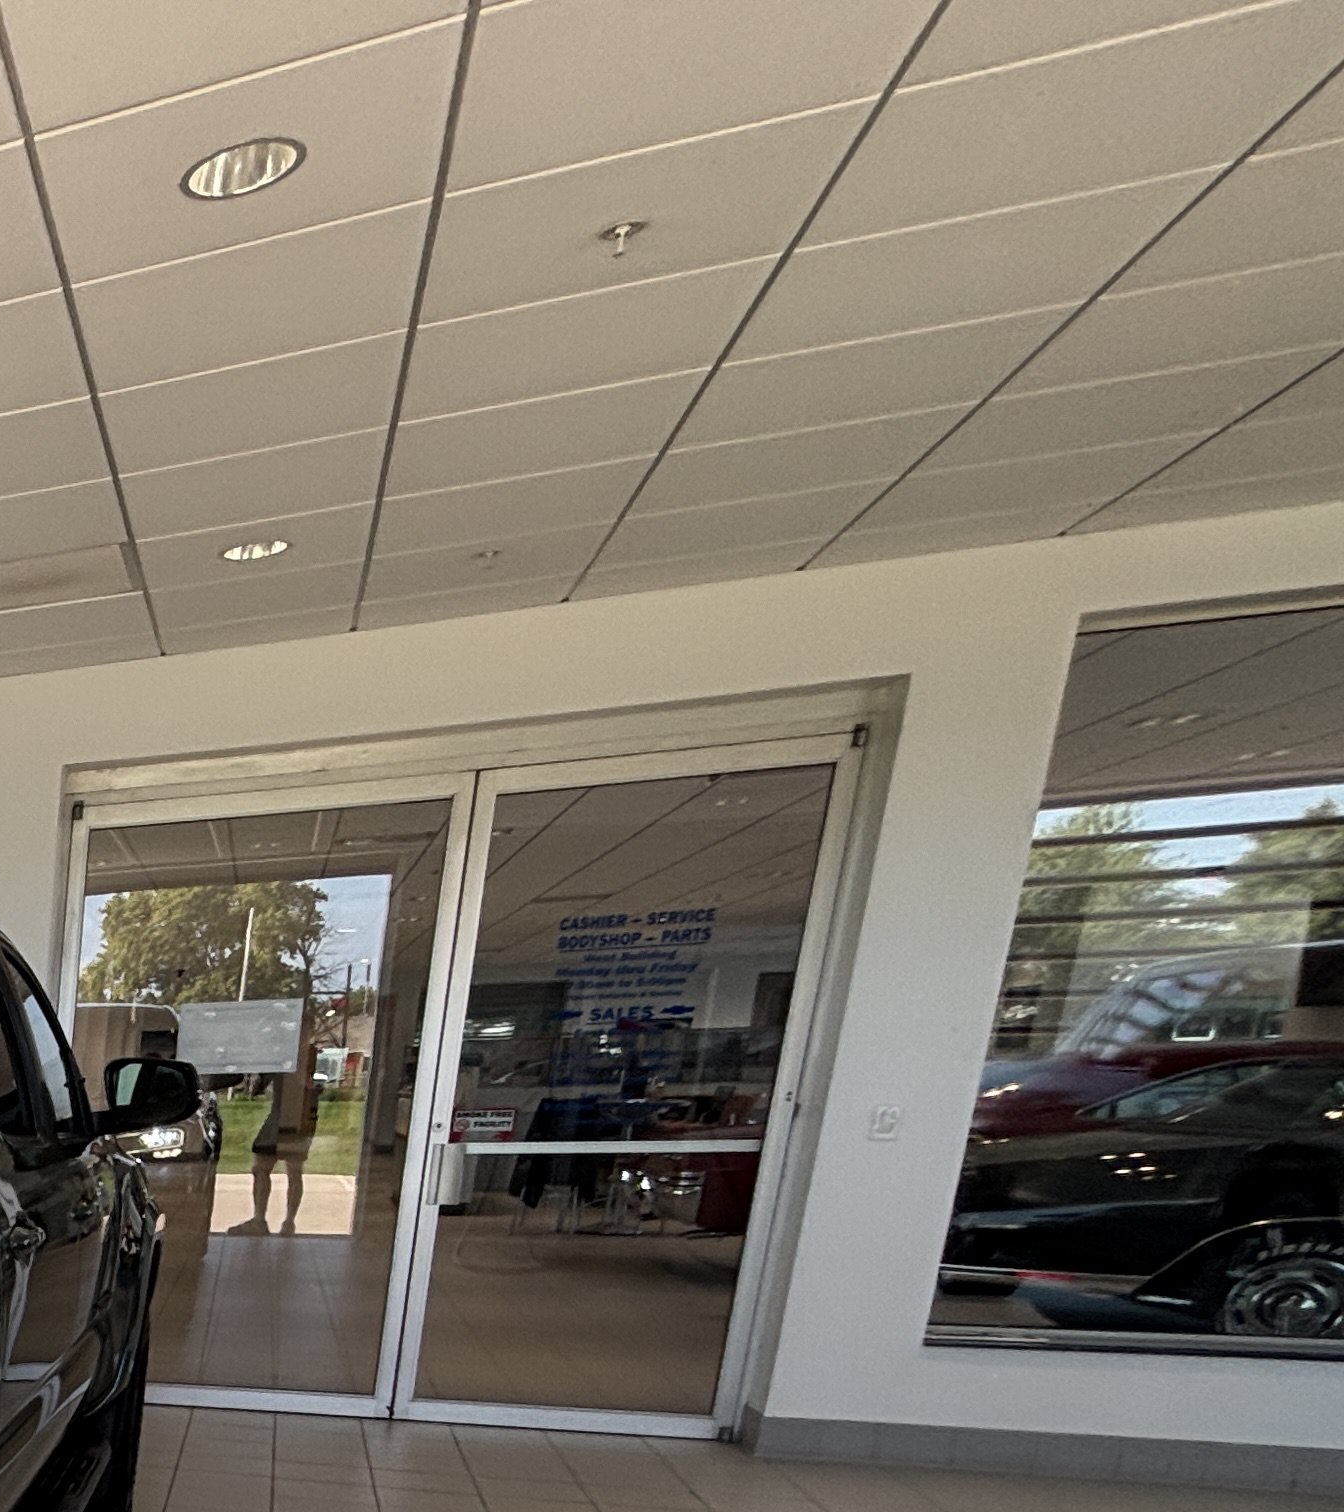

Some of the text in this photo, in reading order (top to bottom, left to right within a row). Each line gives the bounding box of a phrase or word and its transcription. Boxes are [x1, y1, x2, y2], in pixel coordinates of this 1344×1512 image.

[560, 914, 628, 931] CASHIER
[647, 907, 717, 925] SERVICE
[558, 932, 642, 949] BODYSHOP
[660, 927, 712, 943] PARTS
[649, 961, 699, 973] Friday
[589, 1006, 654, 1022] SALES
